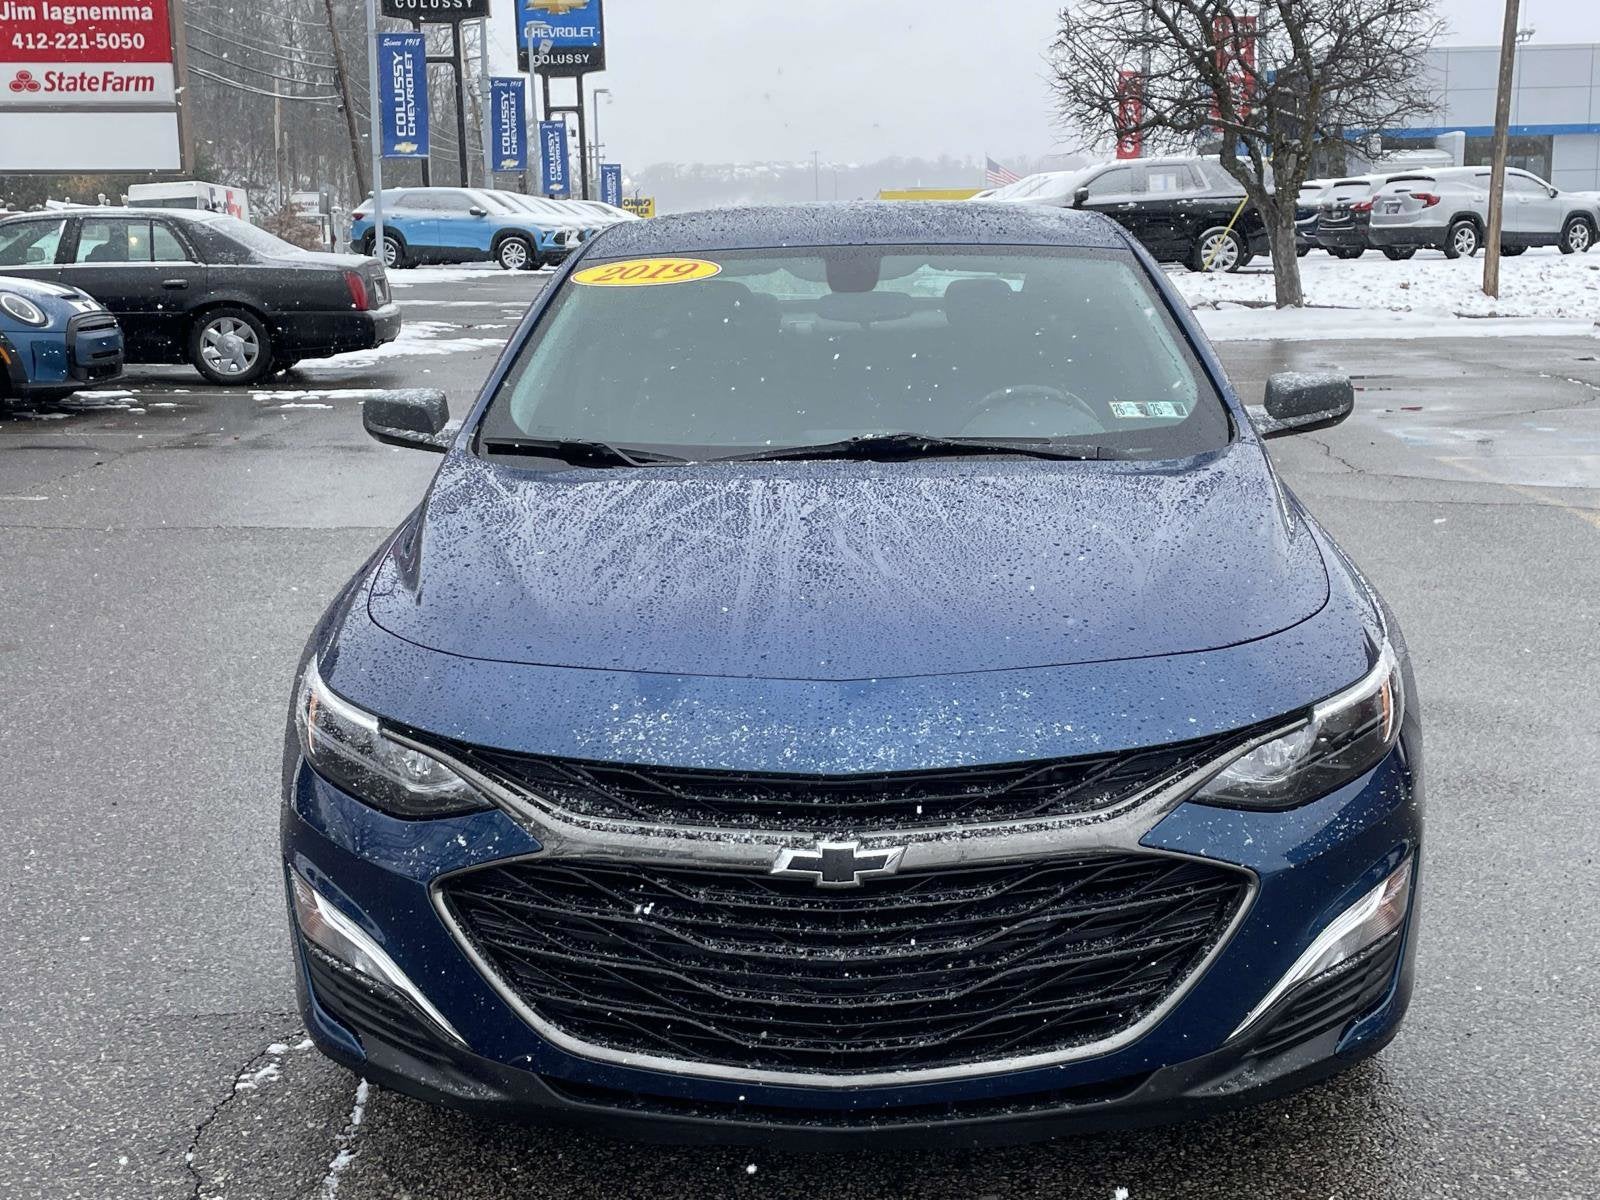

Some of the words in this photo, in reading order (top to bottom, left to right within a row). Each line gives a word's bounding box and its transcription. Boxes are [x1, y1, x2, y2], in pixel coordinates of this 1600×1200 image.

[0, 1, 35, 20] Jim
[12, 33, 145, 49] 412-221-5050
[405, 38, 421, 46] 1918
[524, 27, 595, 38] CHEVROLET
[534, 54, 590, 64] COLUSSY
[393, 51, 406, 136] COLUSSY
[405, 51, 416, 136] CHEVROLET
[501, 90, 510, 155] COLUSSY
[510, 91, 518, 155] CHEVROLET
[592, 263, 700, 282] 2019
